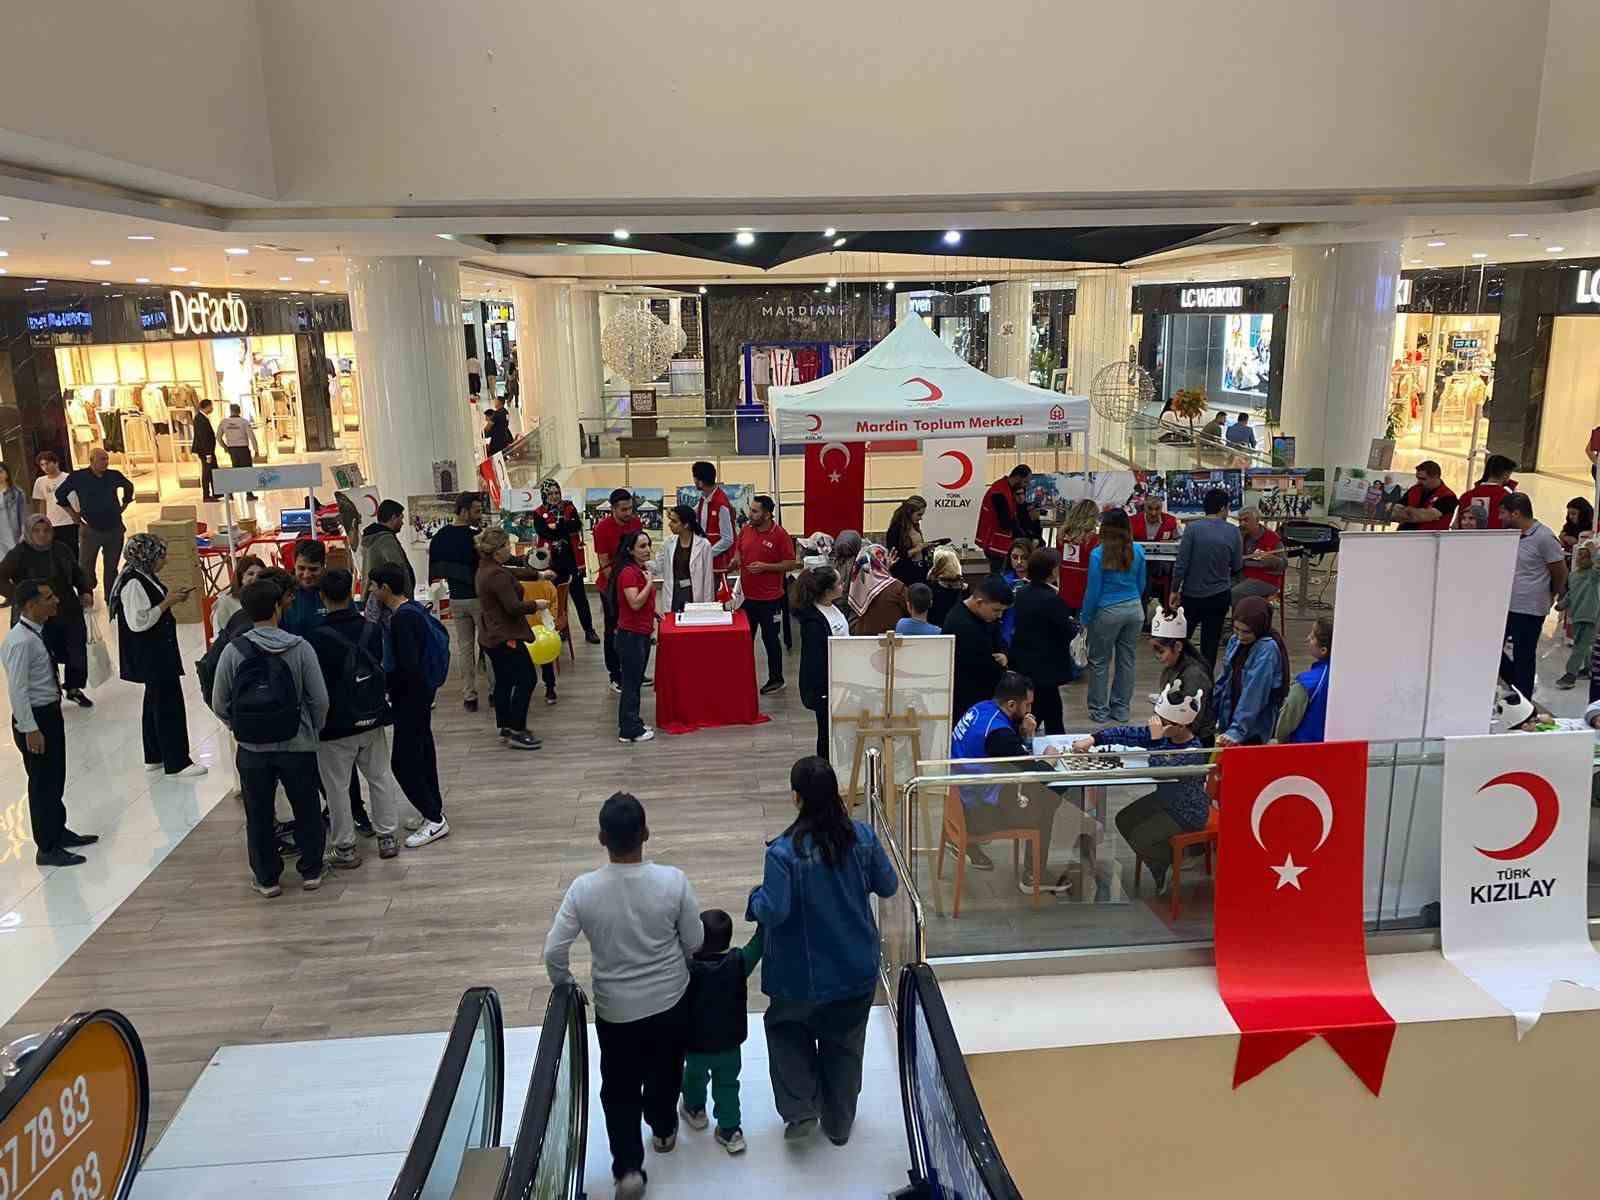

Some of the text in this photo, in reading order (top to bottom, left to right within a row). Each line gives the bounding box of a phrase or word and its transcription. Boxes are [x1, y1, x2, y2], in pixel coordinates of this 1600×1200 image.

[170, 290, 248, 335] DeFacto
[856, 415, 1023, 433] Mardin Toplum Merkezi
[935, 499, 971, 508] KIZILAY
[1496, 868, 1531, 880] TÜRK
[1470, 878, 1556, 905] KIZILAY
[24, 1107, 56, 1173] 78
[60, 1075, 90, 1137] 83
[71, 1151, 101, 1200] 83
